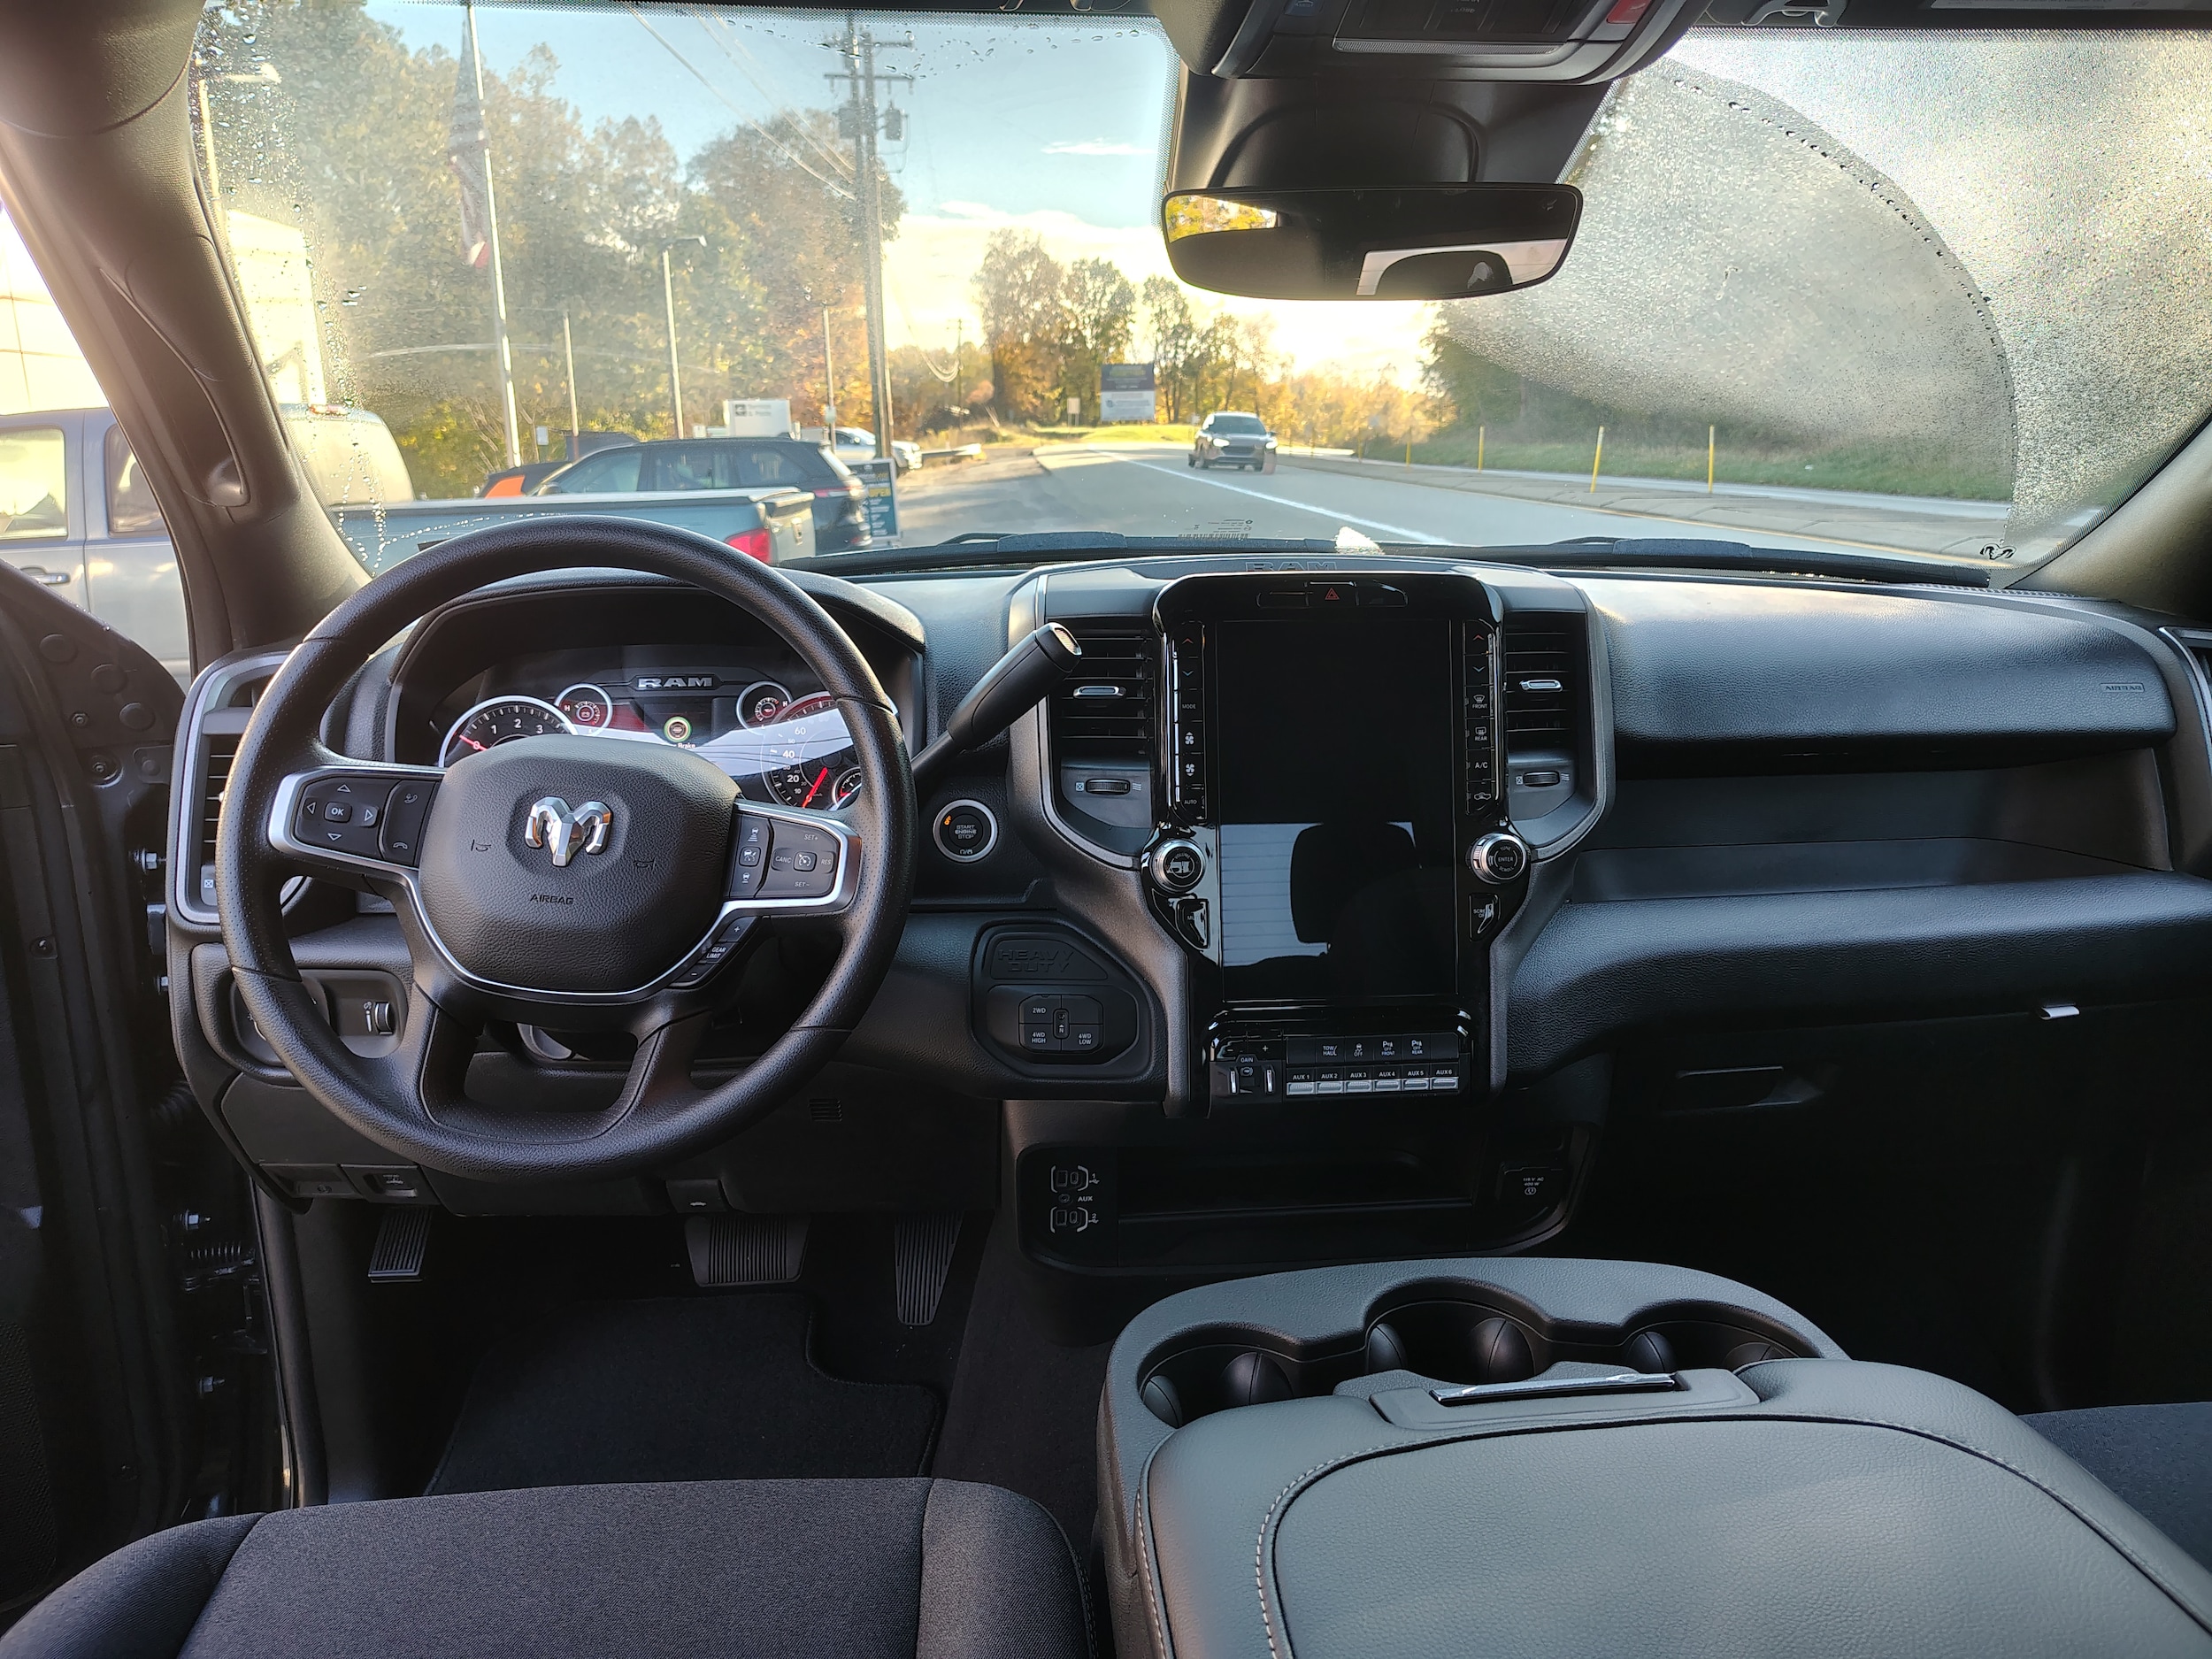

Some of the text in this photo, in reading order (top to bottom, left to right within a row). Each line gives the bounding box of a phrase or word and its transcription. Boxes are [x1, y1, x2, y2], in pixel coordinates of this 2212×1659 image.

[1246, 562, 1338, 572] RAM
[638, 677, 713, 687] RAM
[513, 718, 522, 729] 2
[490, 725, 497, 734] 1
[535, 724, 543, 734] 3
[782, 750, 795, 759] 40
[787, 774, 800, 783] 20
[331, 806, 344, 816] OK
[531, 894, 574, 905] AIRBAG
[998, 949, 1074, 961] HEAVY
[1008, 962, 1070, 972] DUTY
